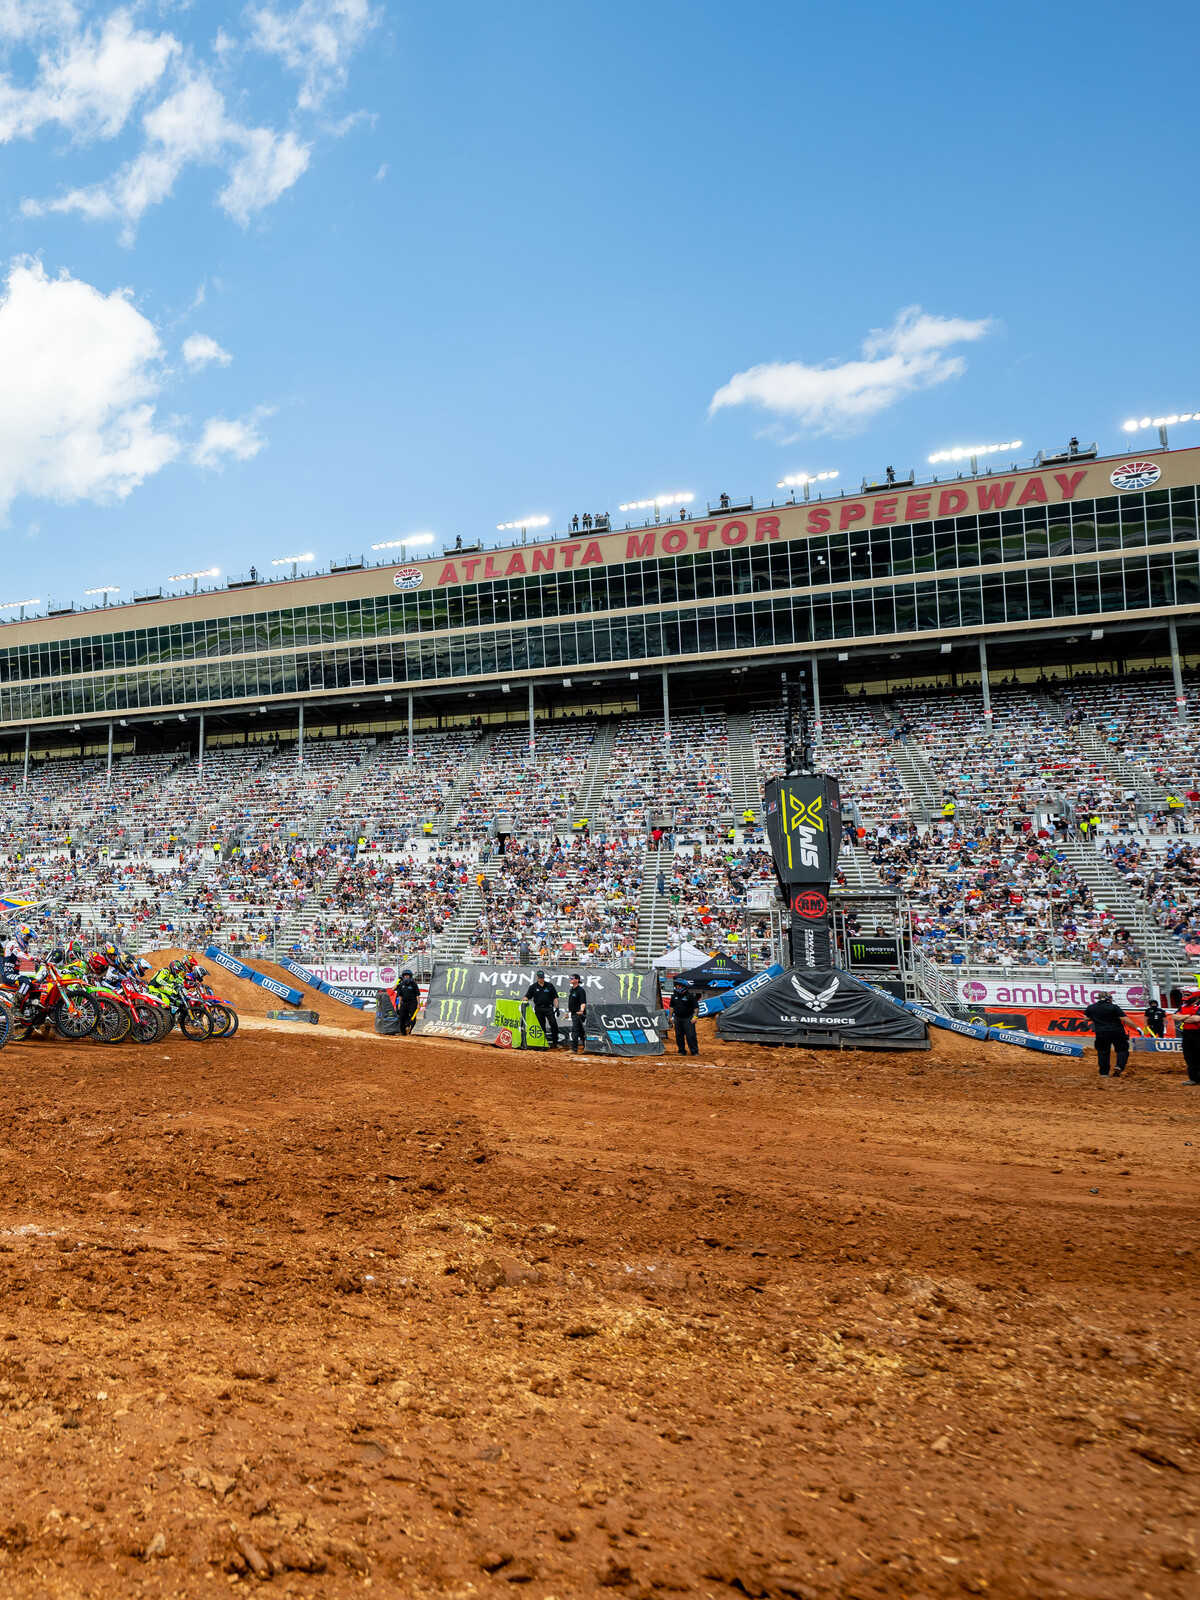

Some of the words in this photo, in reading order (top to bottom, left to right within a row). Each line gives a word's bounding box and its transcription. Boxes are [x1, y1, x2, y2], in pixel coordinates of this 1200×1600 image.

[438, 542, 603, 585] ATLANTA
[625, 516, 781, 559] MOTOR
[806, 470, 1087, 534] SPEEDWAY
[801, 899, 821, 910] RM
[216, 953, 243, 975] WPS
[288, 963, 312, 983] WPS
[262, 978, 290, 998] WPS
[735, 972, 773, 998] WPS
[328, 987, 354, 1005] WPS
[601, 1014, 652, 1029] GoPro
[780, 1015, 798, 1023] U.S.
[819, 1017, 856, 1025] FORCE
[912, 1008, 936, 1022] WPS
[454, 1021, 484, 1030] MOUNTAIN
[951, 1023, 976, 1036] WPS
[1000, 1033, 1026, 1045] WPS
[1044, 1042, 1071, 1054] WPS
